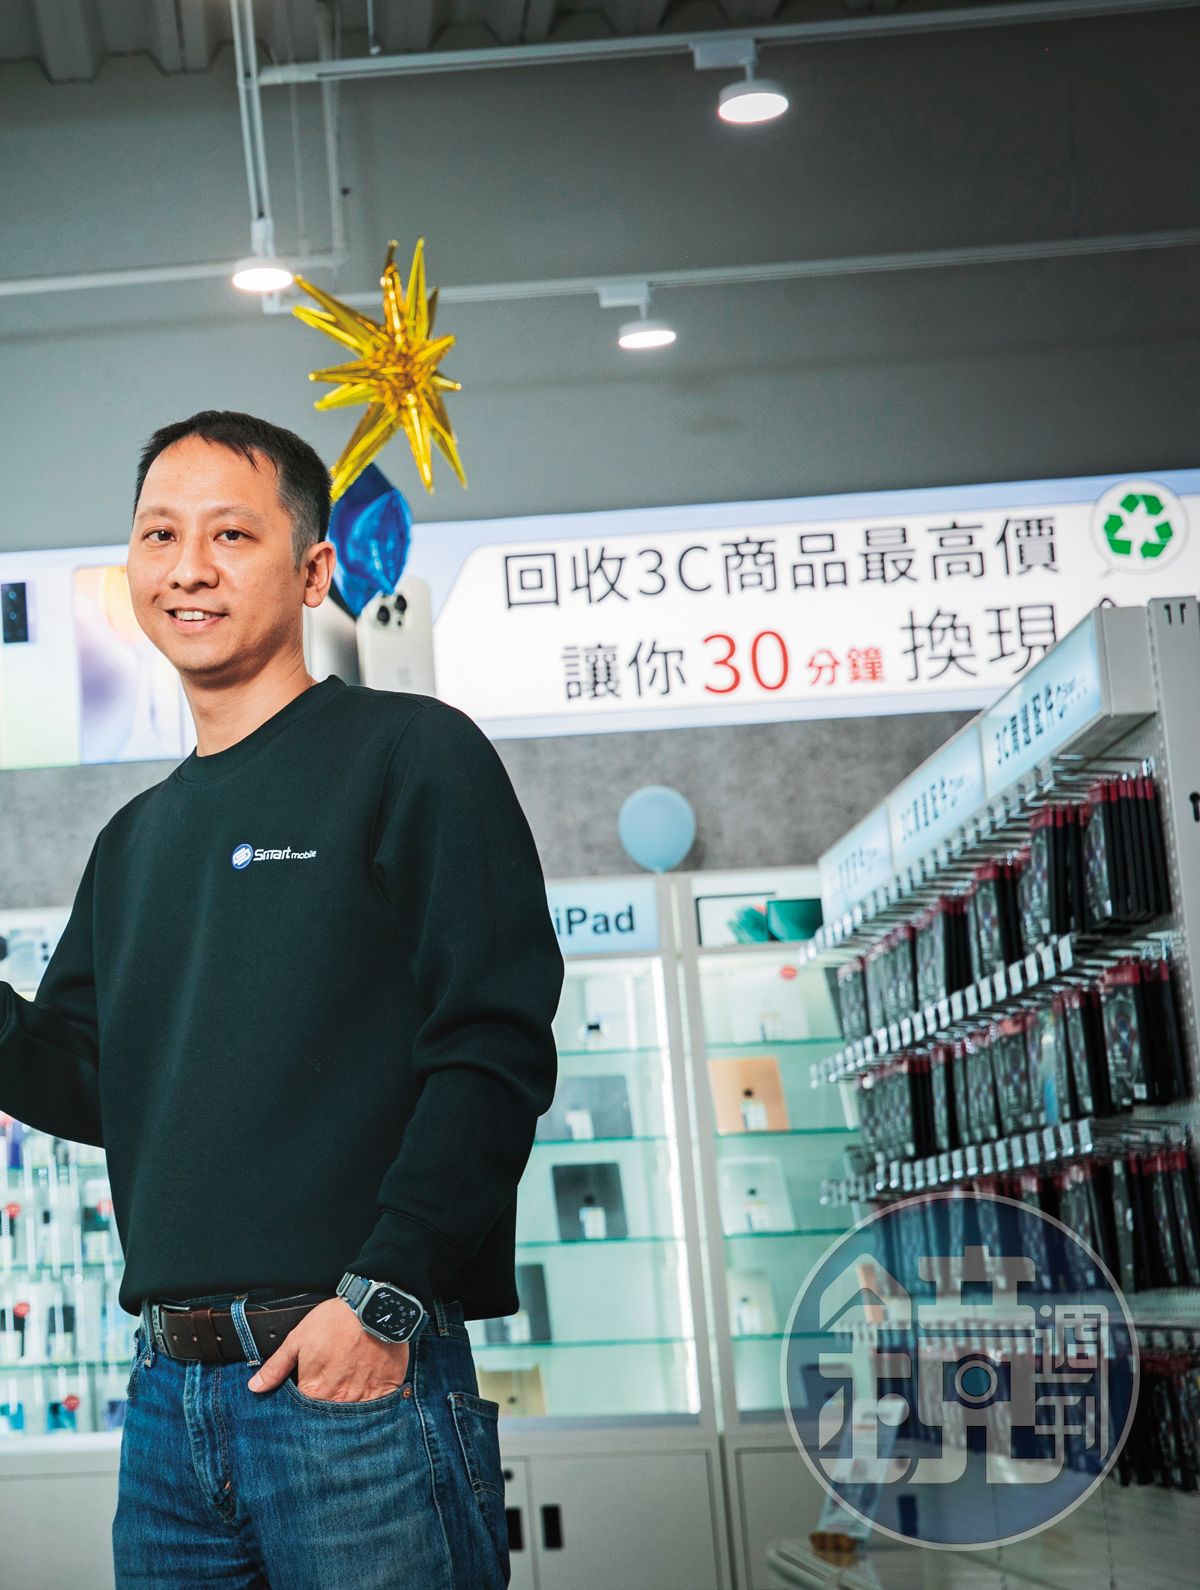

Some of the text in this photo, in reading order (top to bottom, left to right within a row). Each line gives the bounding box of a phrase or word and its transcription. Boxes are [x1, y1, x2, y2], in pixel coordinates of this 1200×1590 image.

[503, 515, 1061, 611] 回收3C商品最高價
[253, 846, 291, 861] Smart
[556, 904, 636, 936] iPad
